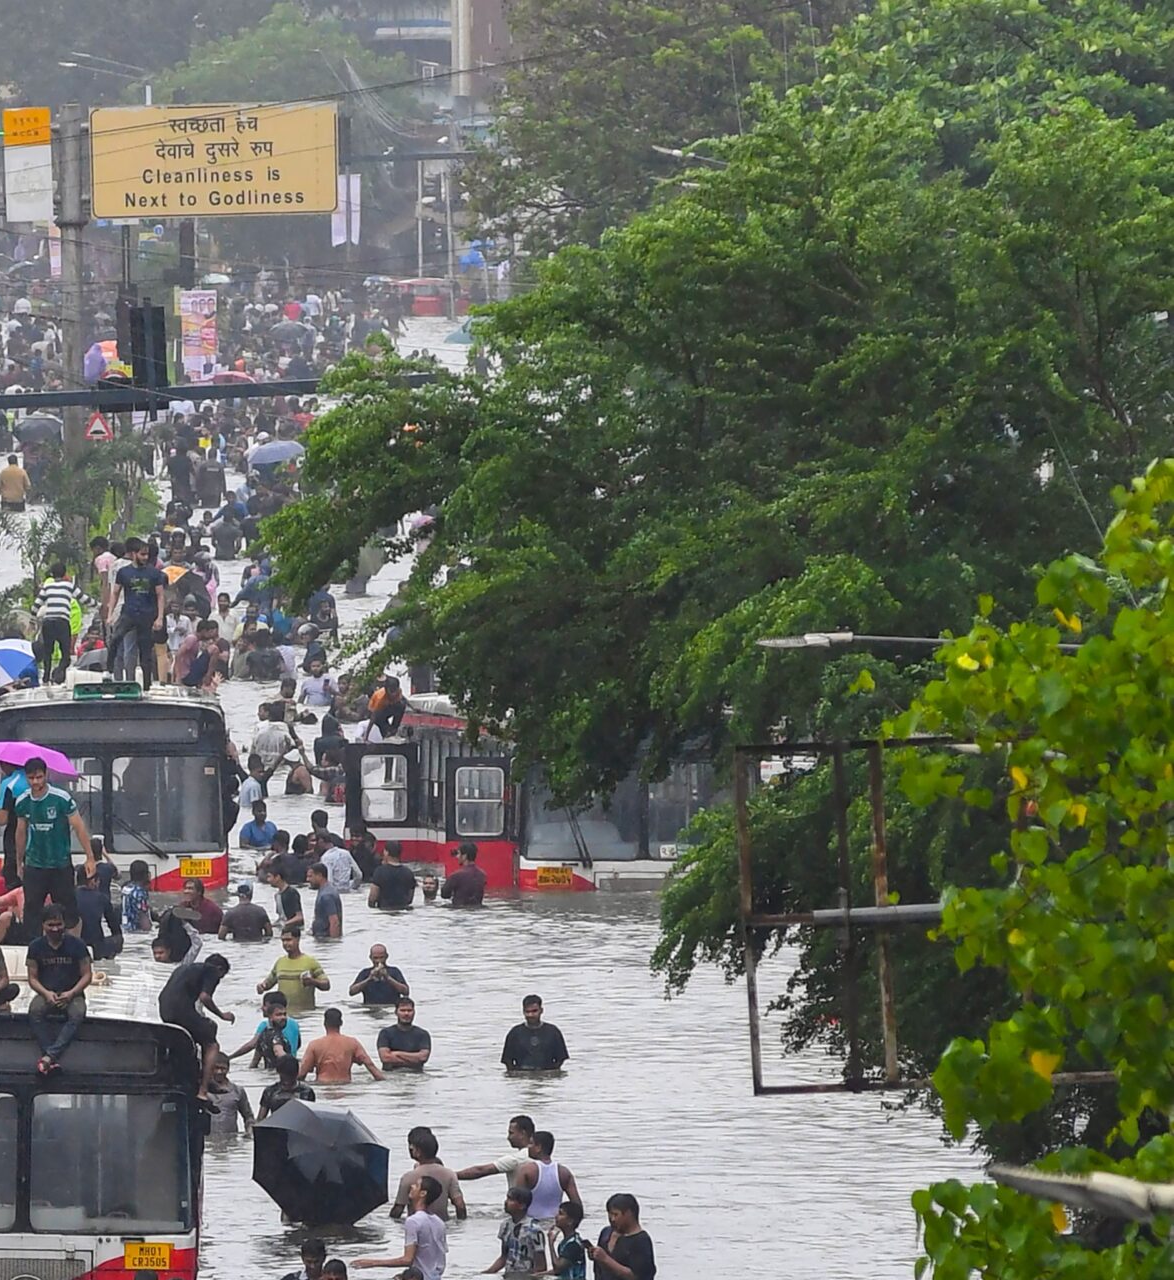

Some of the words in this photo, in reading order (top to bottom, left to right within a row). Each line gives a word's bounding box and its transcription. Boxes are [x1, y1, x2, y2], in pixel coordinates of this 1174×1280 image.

[169, 117, 225, 134] स्वच्छता
[155, 138, 195, 160] देवाचे
[204, 136, 240, 164] दुसरे
[142, 168, 254, 184] Cleanliness
[267, 166, 281, 181] is
[124, 192, 168, 208] Next
[179, 192, 197, 206] to
[208, 190, 305, 206] Godliness
[138, 1246, 162, 1257] MH01
[132, 1256, 168, 1268] CR3505
